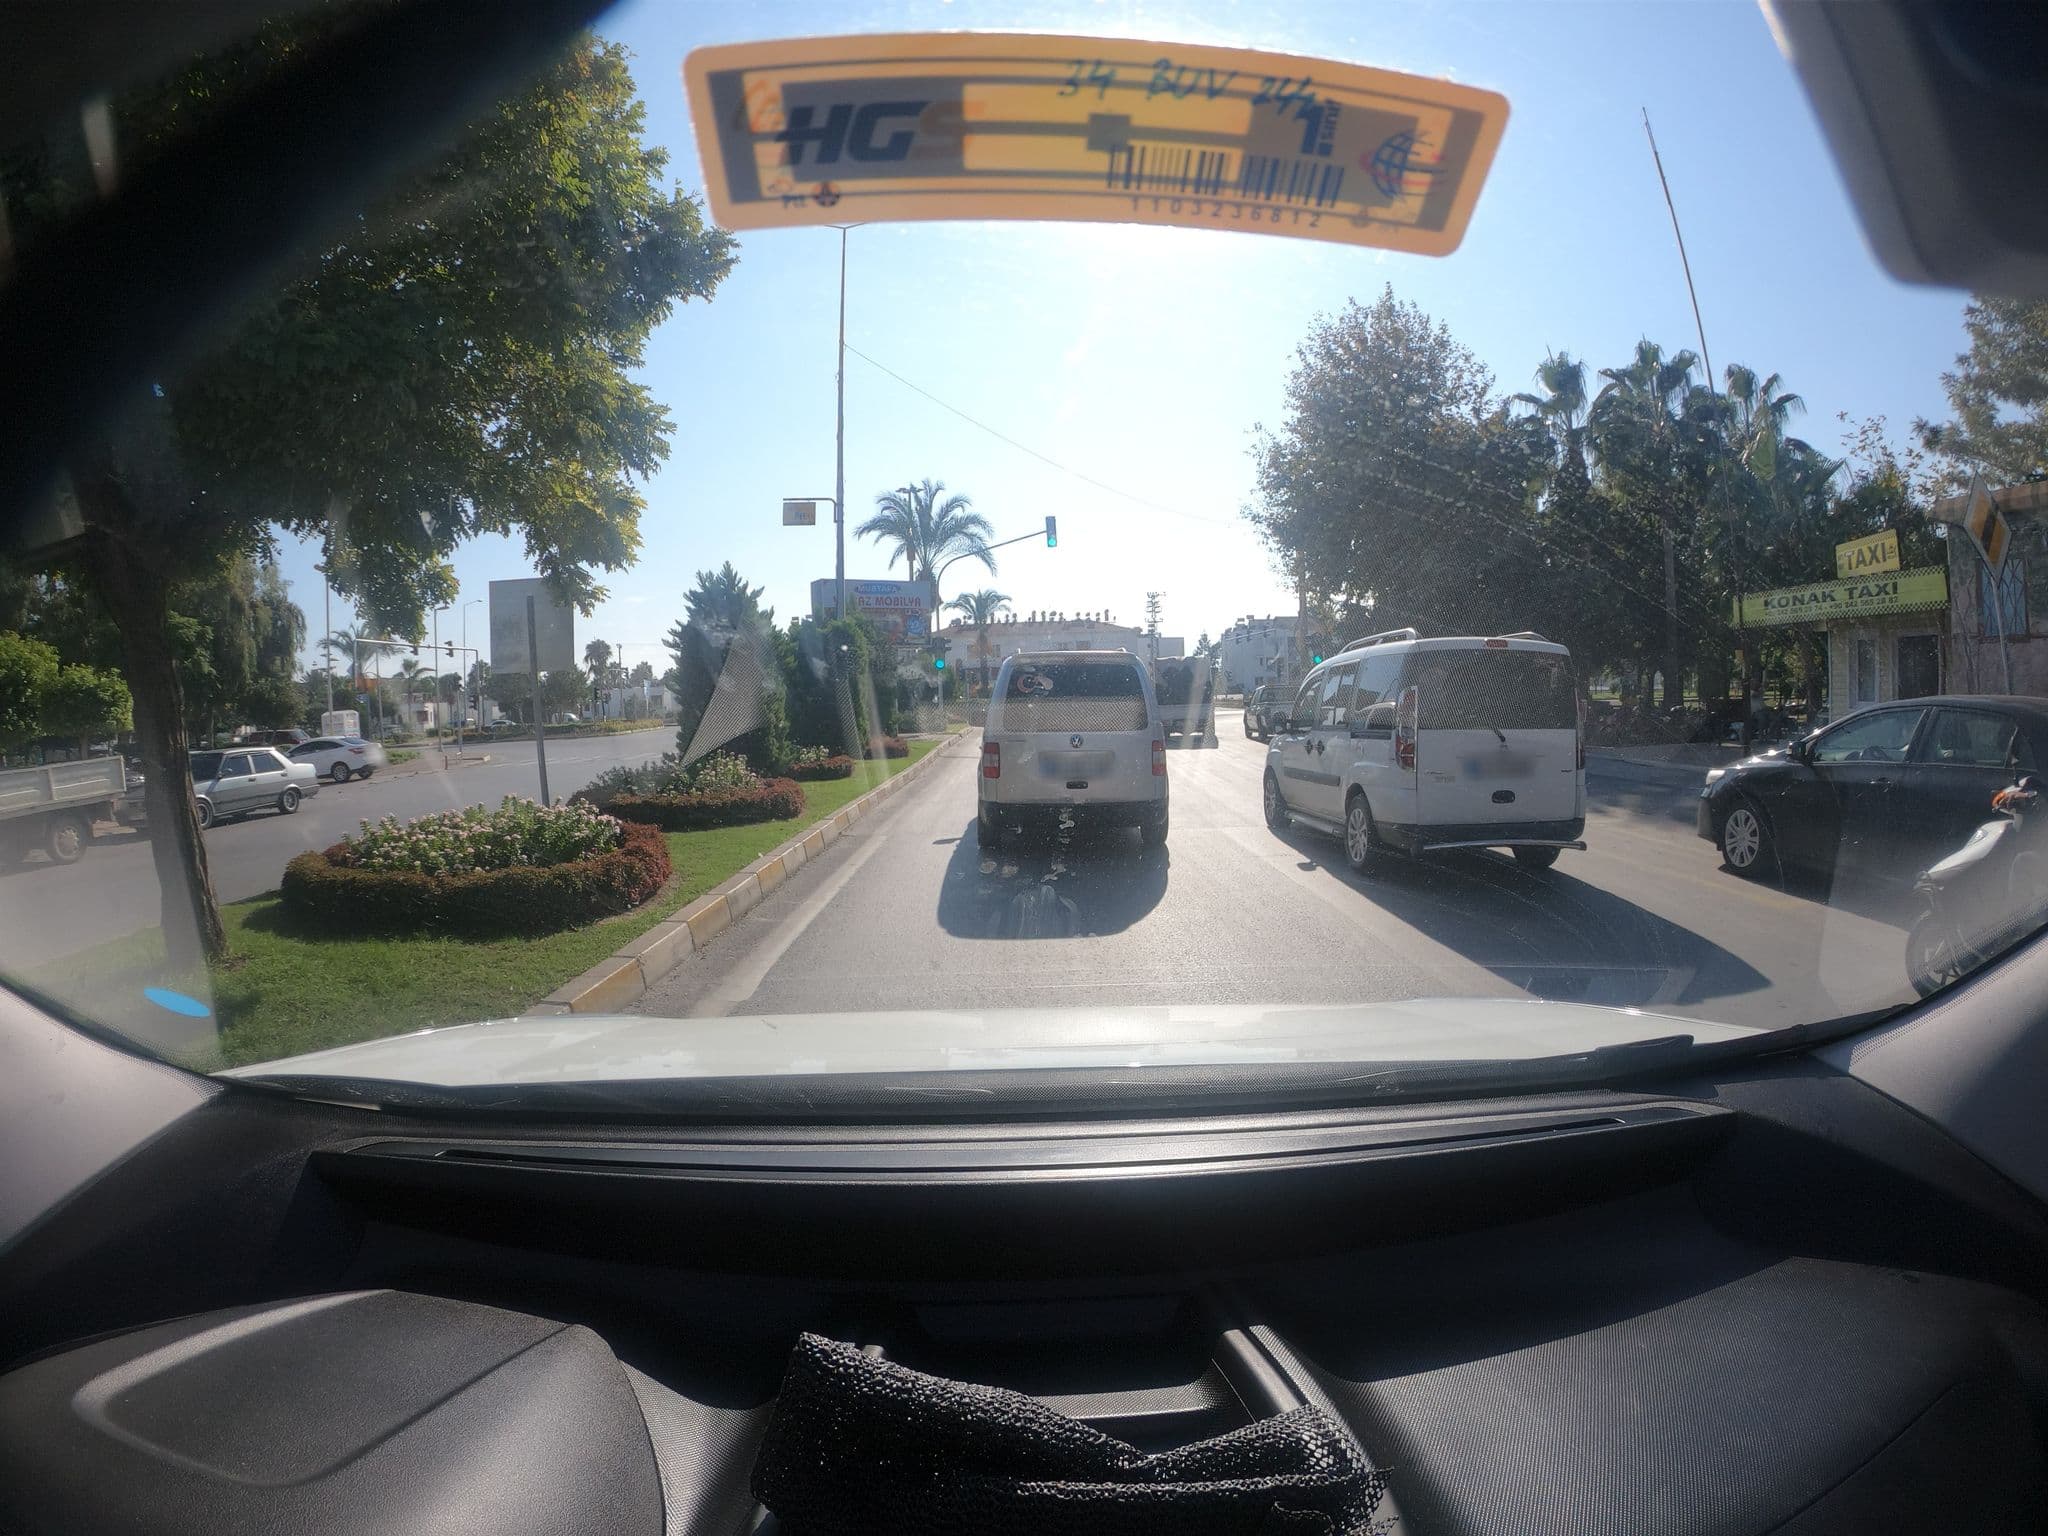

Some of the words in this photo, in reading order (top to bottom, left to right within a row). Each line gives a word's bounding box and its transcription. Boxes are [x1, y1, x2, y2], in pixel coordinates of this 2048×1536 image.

[1057, 58, 1117, 100] 34
[1844, 542, 1886, 571] TAXI
[1764, 590, 1836, 609] KONAK
[1844, 582, 1899, 599] TAXI
